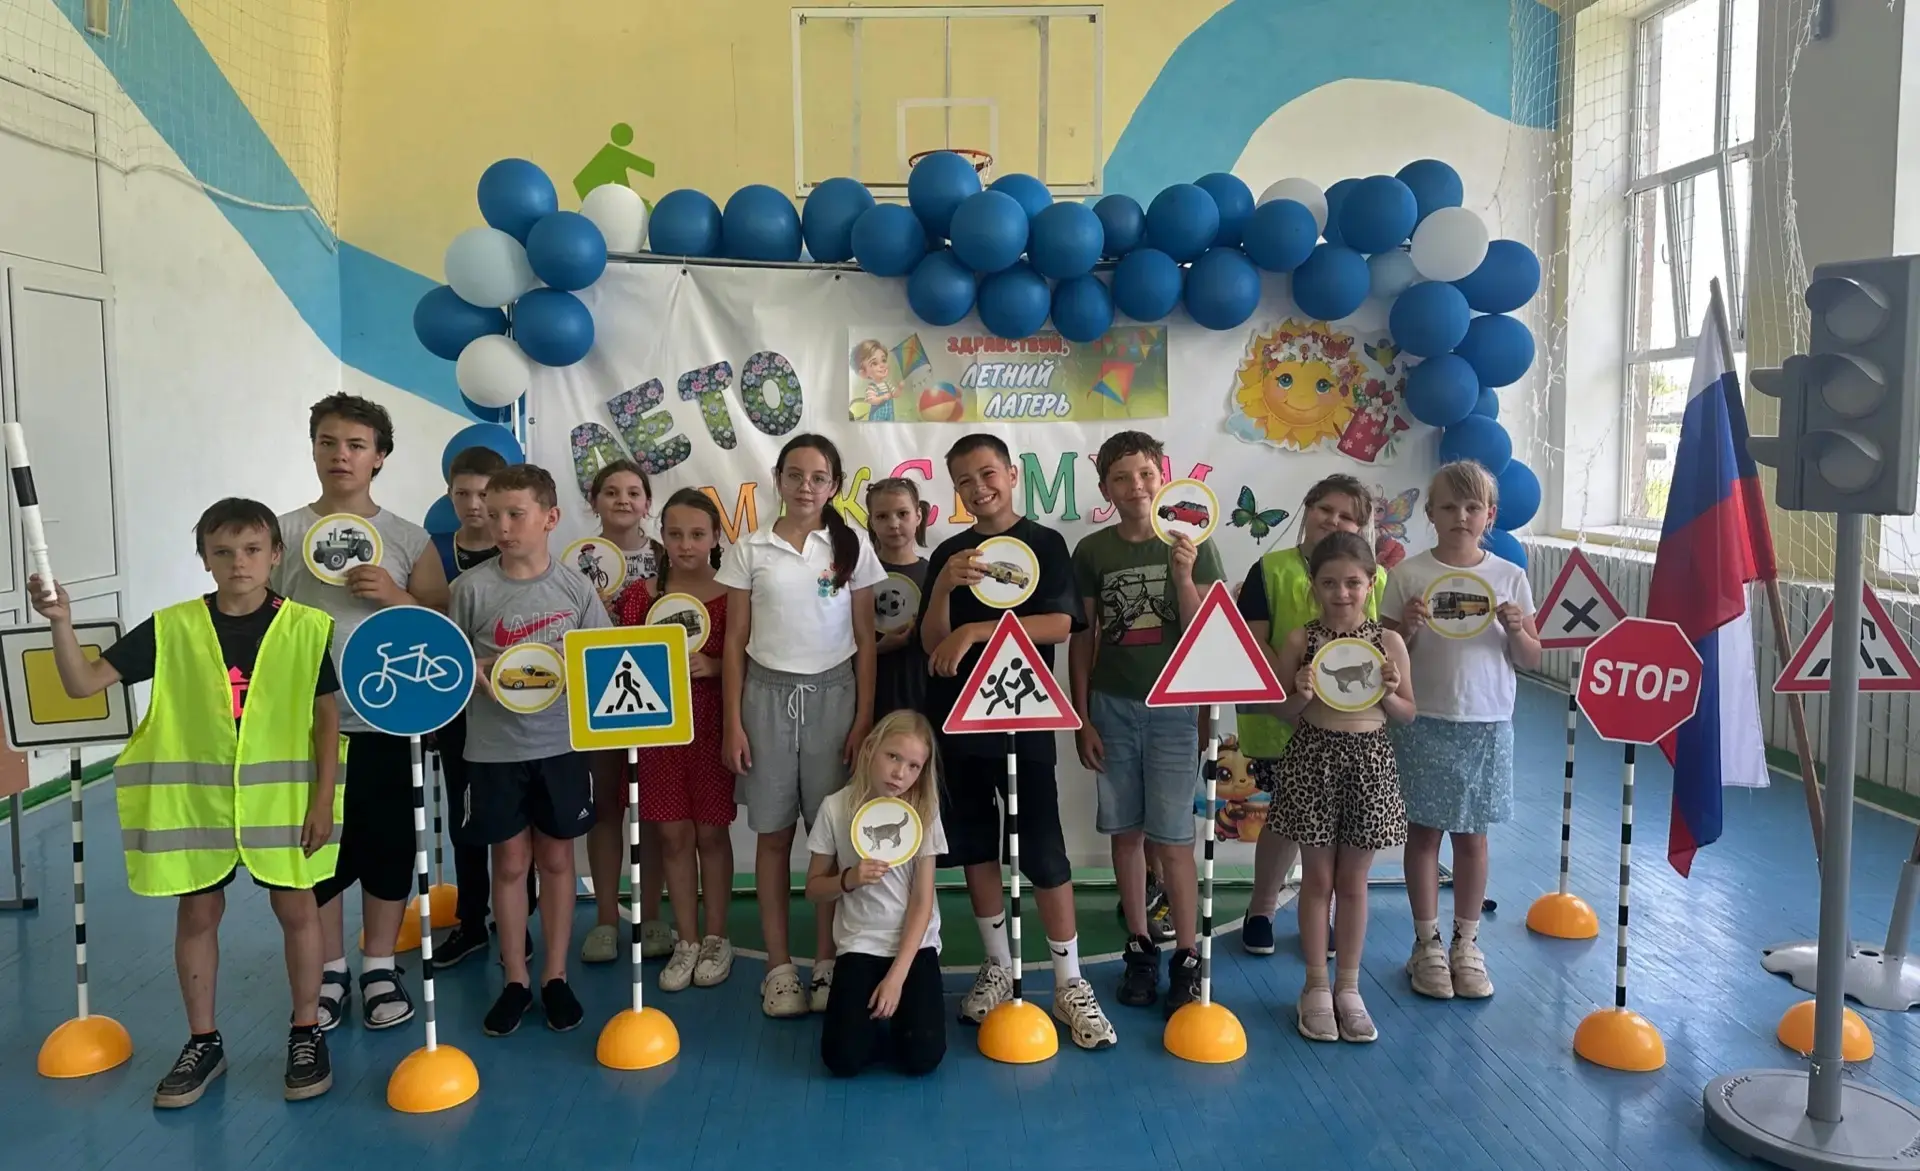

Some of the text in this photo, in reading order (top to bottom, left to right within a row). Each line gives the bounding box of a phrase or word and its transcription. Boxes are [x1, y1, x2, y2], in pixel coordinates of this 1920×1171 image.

[961, 358, 1055, 389] ЛЕТНИЙ
[984, 392, 1072, 419] ЛАГЕРЬ
[571, 351, 803, 507] ЛЕТО
[505, 611, 565, 648] AIR
[1589, 658, 1690, 702] STOP
